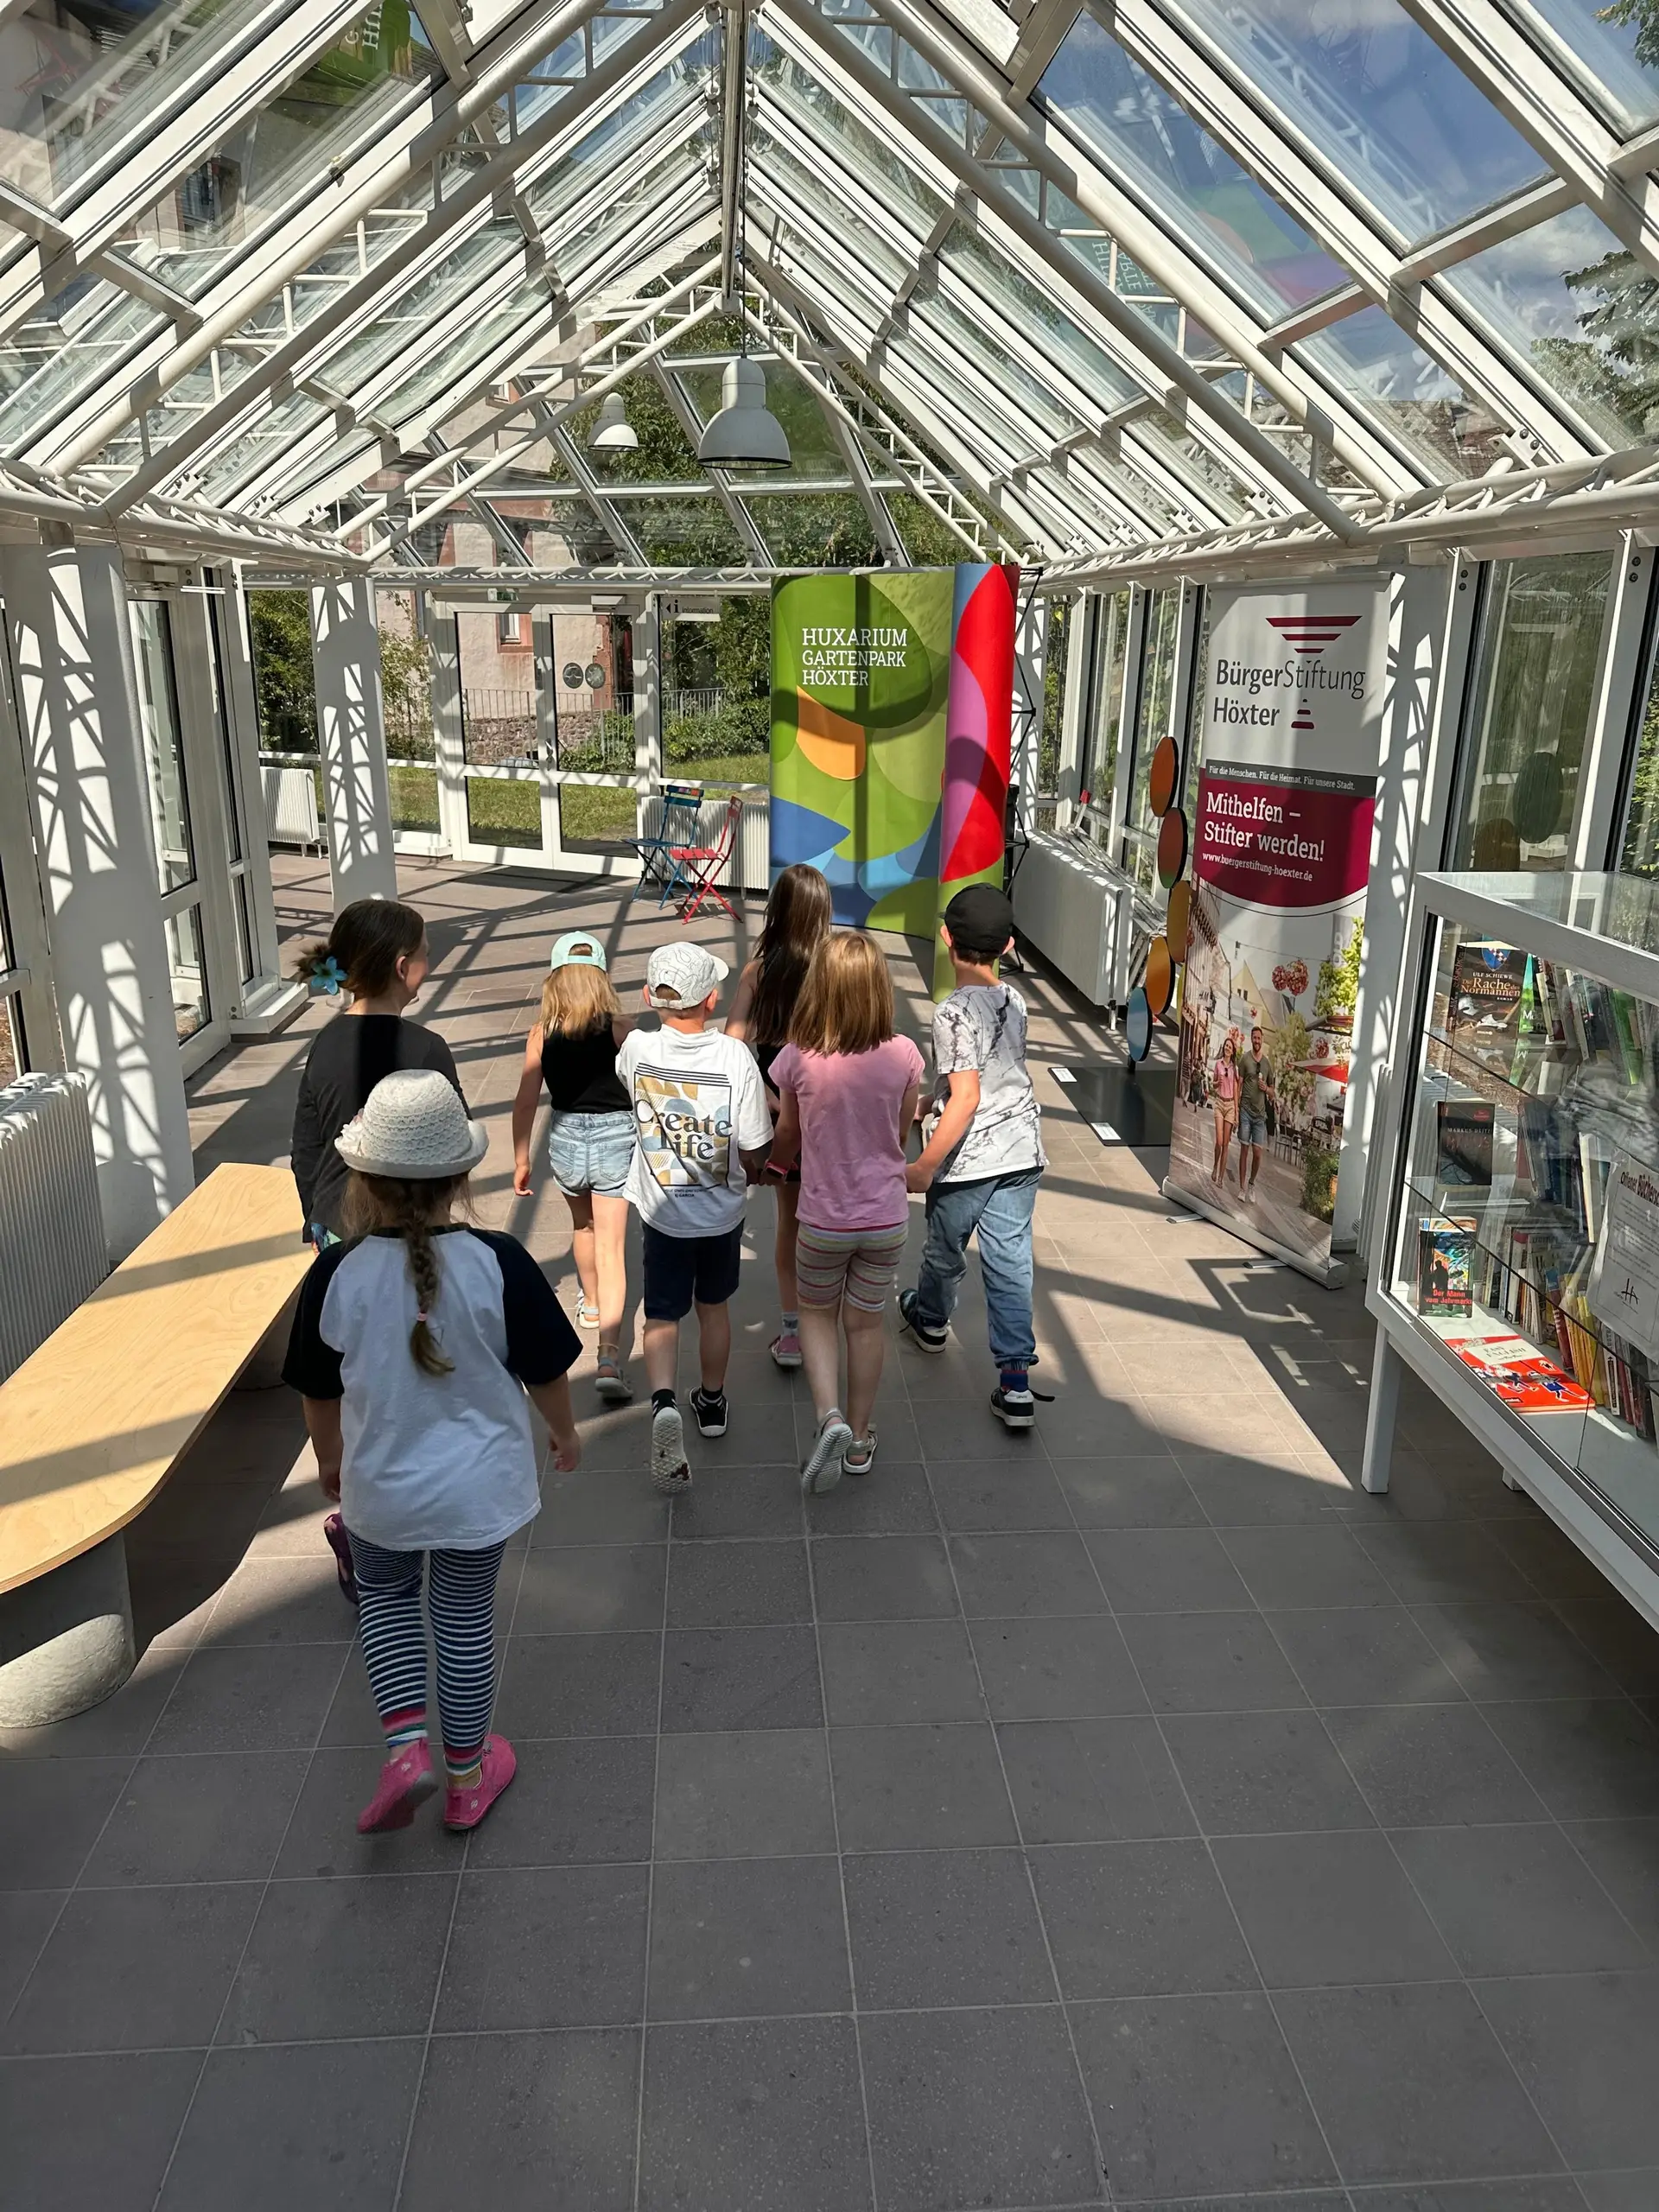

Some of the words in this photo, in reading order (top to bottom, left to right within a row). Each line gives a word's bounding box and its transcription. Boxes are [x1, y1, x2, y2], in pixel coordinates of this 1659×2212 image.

[802, 628, 907, 646] HUXARIUM
[802, 650, 906, 667] GARTENPARK
[802, 666, 868, 686] HÖXTER
[1217, 659, 1365, 700] BürgerStiftung
[1213, 696, 1280, 726] Höxter
[1210, 766, 1218, 774] Für
[1219, 766, 1228, 775] die
[1229, 767, 1258, 779] Menschen.
[1259, 771, 1269, 780] Für
[1279, 773, 1302, 784] Heimat.
[1304, 776, 1314, 785] Für
[1315, 779, 1336, 788] unsere
[1336, 780, 1355, 791] Stadt.
[1206, 791, 1283, 823] Mithelfen
[1204, 820, 1253, 849] Stifter
[1257, 833, 1325, 862] werden!
[1202, 852, 1313, 881] www.buergerstiftung-hoexter.de
[1460, 984, 1521, 996] Normannen
[1472, 977, 1510, 990] Rache
[635, 1098, 733, 1137] Create
